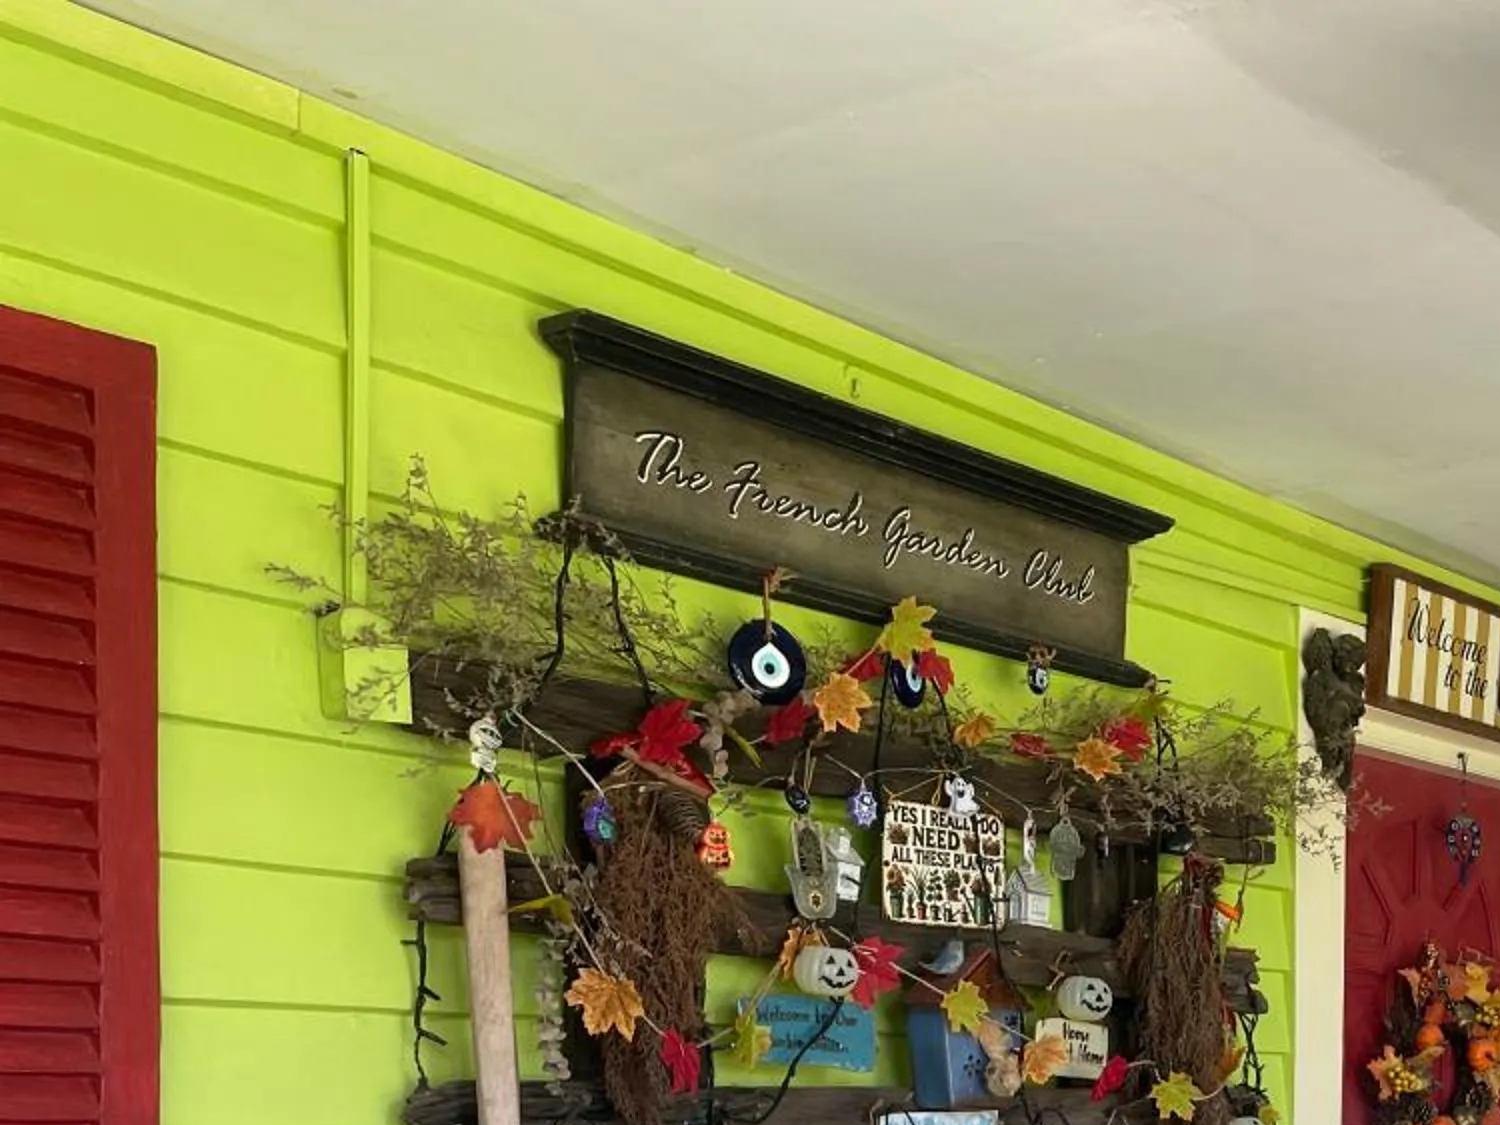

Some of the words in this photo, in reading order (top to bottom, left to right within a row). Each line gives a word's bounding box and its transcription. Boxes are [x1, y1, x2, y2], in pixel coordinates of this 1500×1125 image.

[635, 431, 713, 496] The
[724, 460, 870, 538] French
[882, 505, 1010, 580] Garden
[1022, 550, 1095, 605] Club
[1407, 597, 1488, 665] Welcome
[1443, 662, 1458, 691] to
[1464, 667, 1489, 700] the
[892, 804, 918, 825] YES
[921, 808, 926, 825] I
[981, 818, 1000, 836] DO
[911, 825, 960, 851] NEED
[891, 846, 913, 863] ALL
[914, 849, 951, 868] THESE
